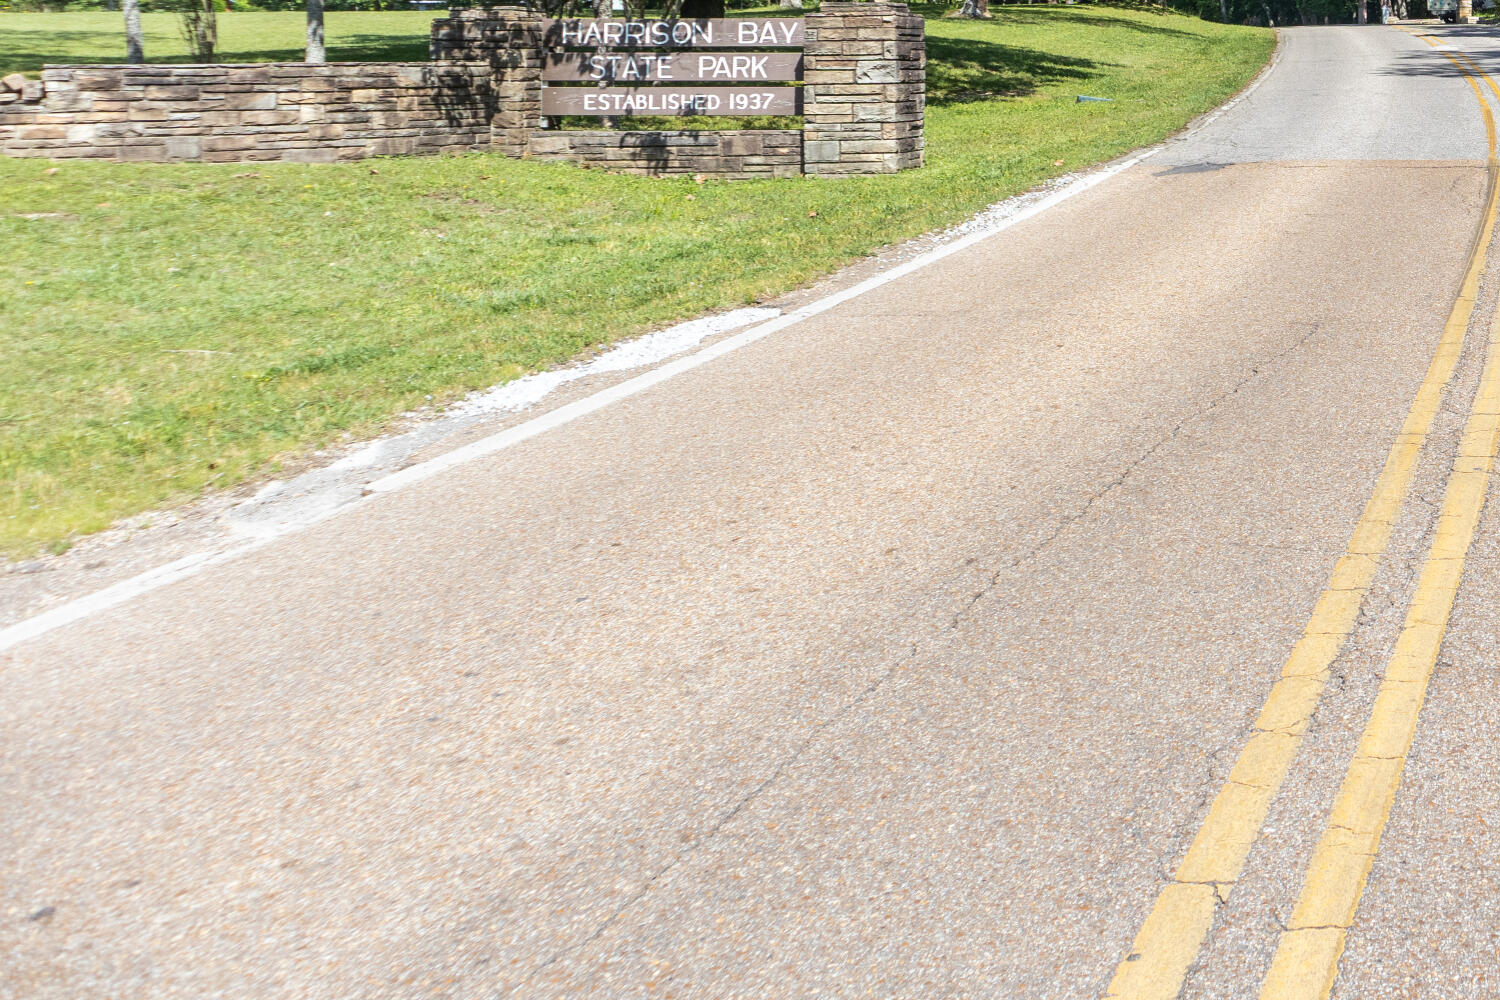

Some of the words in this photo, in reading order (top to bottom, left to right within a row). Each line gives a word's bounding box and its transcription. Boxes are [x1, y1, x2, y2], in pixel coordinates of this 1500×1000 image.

[561, 21, 713, 45] HARRISON
[738, 21, 798, 44] BAY
[590, 56, 673, 79] STATE
[698, 56, 768, 79] PARK
[583, 94, 720, 111] ESTABLISHED
[729, 93, 775, 110] 1937
